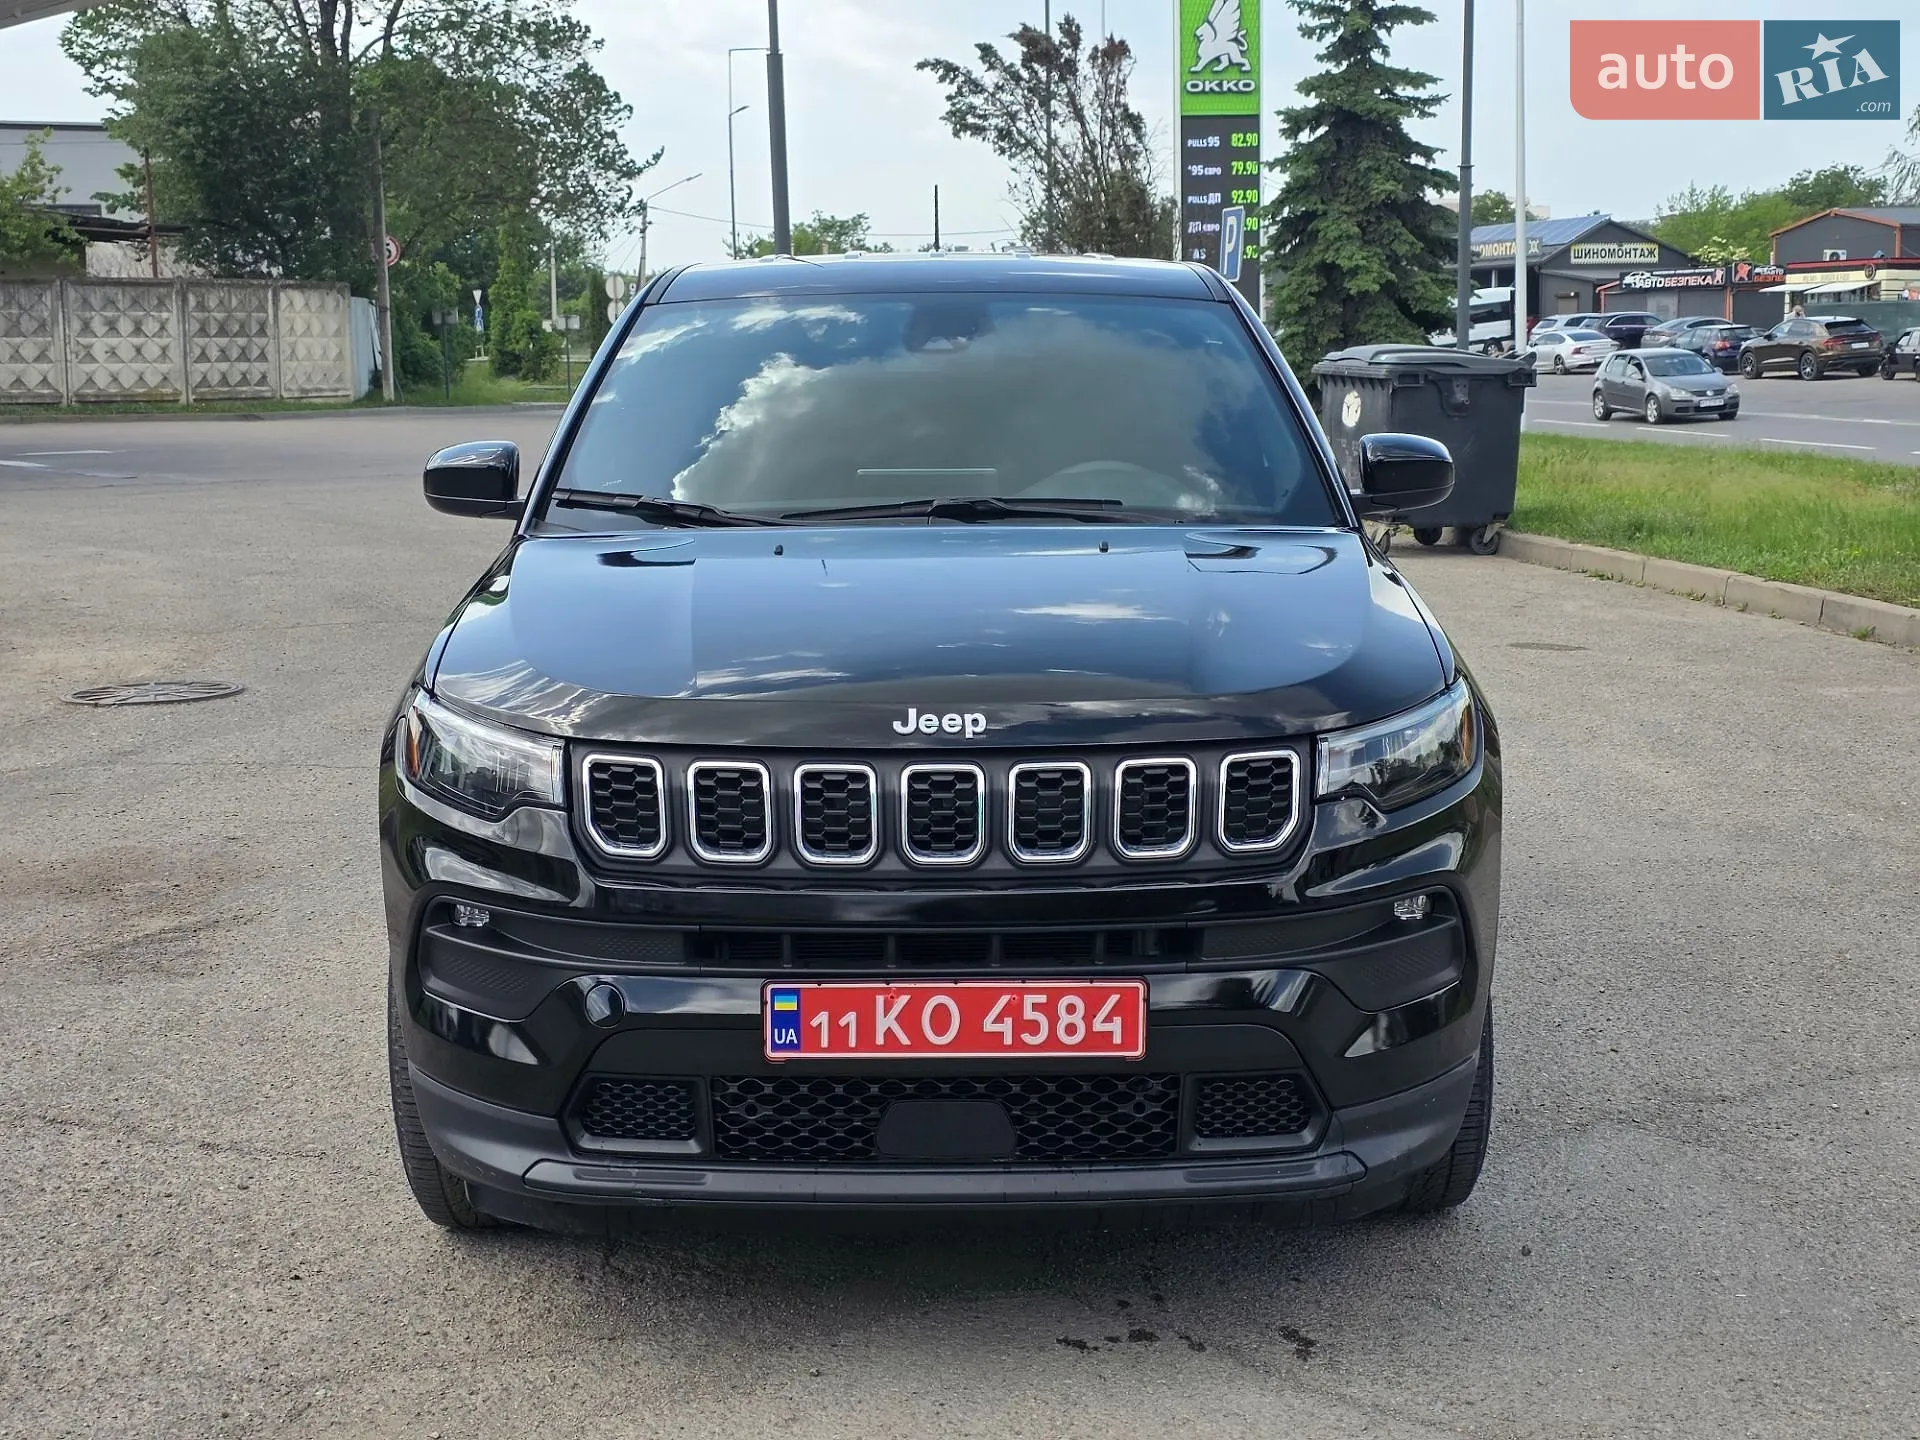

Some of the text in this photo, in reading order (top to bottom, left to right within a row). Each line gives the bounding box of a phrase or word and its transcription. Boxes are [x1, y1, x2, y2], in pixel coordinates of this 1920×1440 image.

[1186, 80, 1256, 93] OKKO
[1231, 132, 1258, 148] 82.90
[1231, 161, 1258, 175] 79.90
[1231, 189, 1258, 204] 92.90
[1243, 217, 1258, 231] .90
[1224, 215, 1238, 275] P
[1573, 242, 1657, 260] ШИНОМОНТАЖ
[892, 708, 987, 739] Jeep
[983, 994, 1122, 1046] 4584
[774, 1027, 798, 1045] UA
